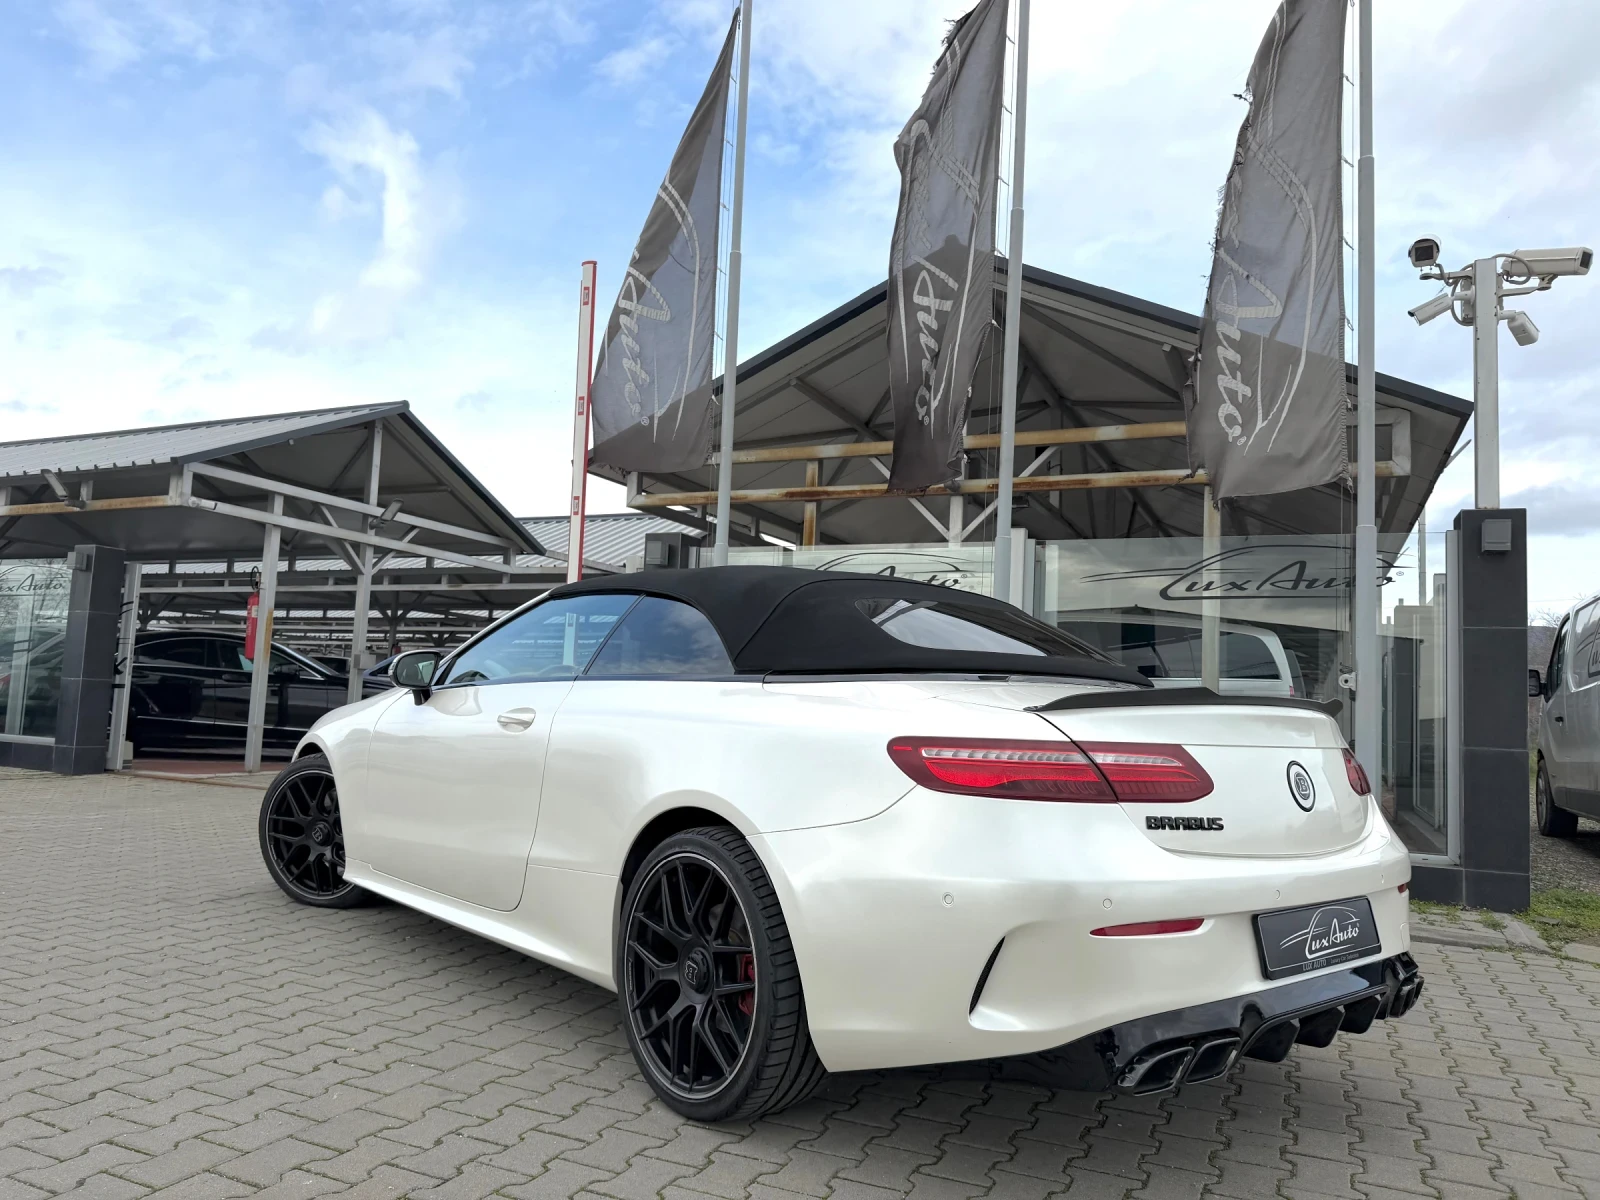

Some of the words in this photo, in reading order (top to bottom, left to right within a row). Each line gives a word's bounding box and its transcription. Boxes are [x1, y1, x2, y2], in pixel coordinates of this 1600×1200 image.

[1146, 816, 1224, 831] BRABUS
[1303, 961, 1313, 971] LUX
[1314, 959, 1327, 968] AUTO
